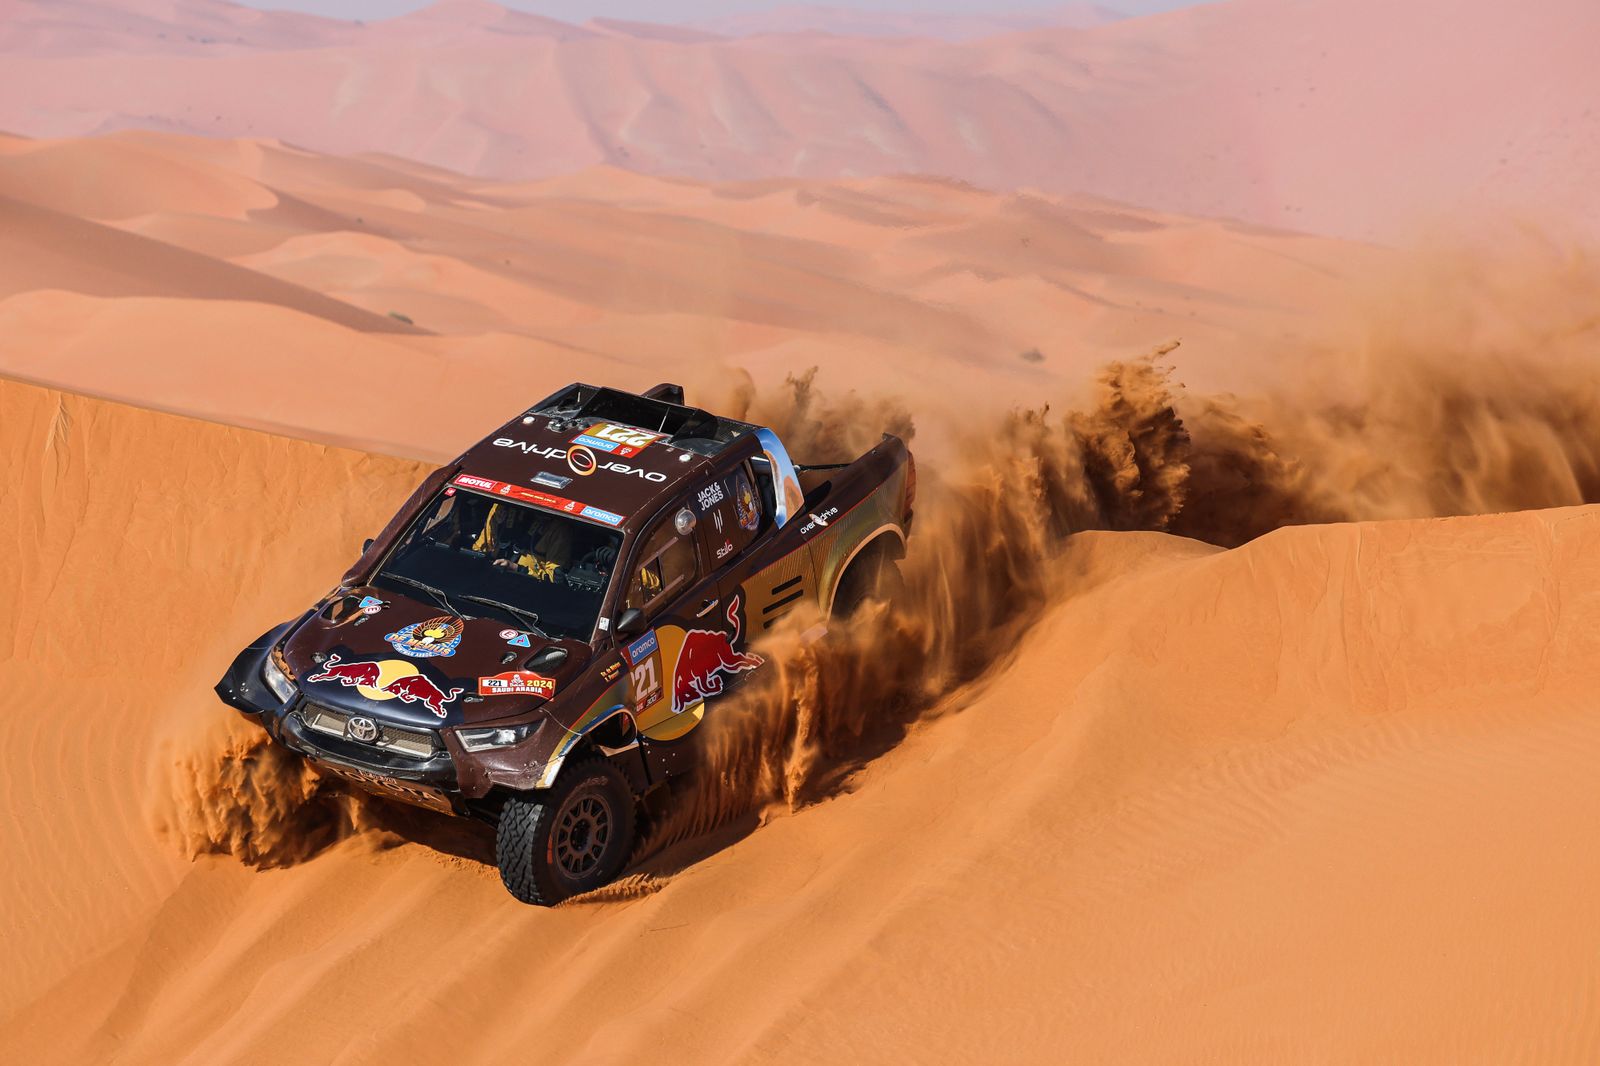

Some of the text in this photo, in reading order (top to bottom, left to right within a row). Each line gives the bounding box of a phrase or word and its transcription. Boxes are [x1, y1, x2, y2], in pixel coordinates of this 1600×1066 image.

[578, 436, 614, 450] aramco
[596, 424, 657, 447] 221
[493, 438, 667, 483] over drive
[458, 477, 492, 489] MOTUL
[697, 481, 721, 502] JACK&
[701, 490, 724, 511] JONES
[584, 508, 619, 522] aramco
[631, 637, 655, 658] aramco
[526, 680, 553, 690] 2024
[630, 656, 658, 702] 21
[515, 686, 543, 694] ARABIA
